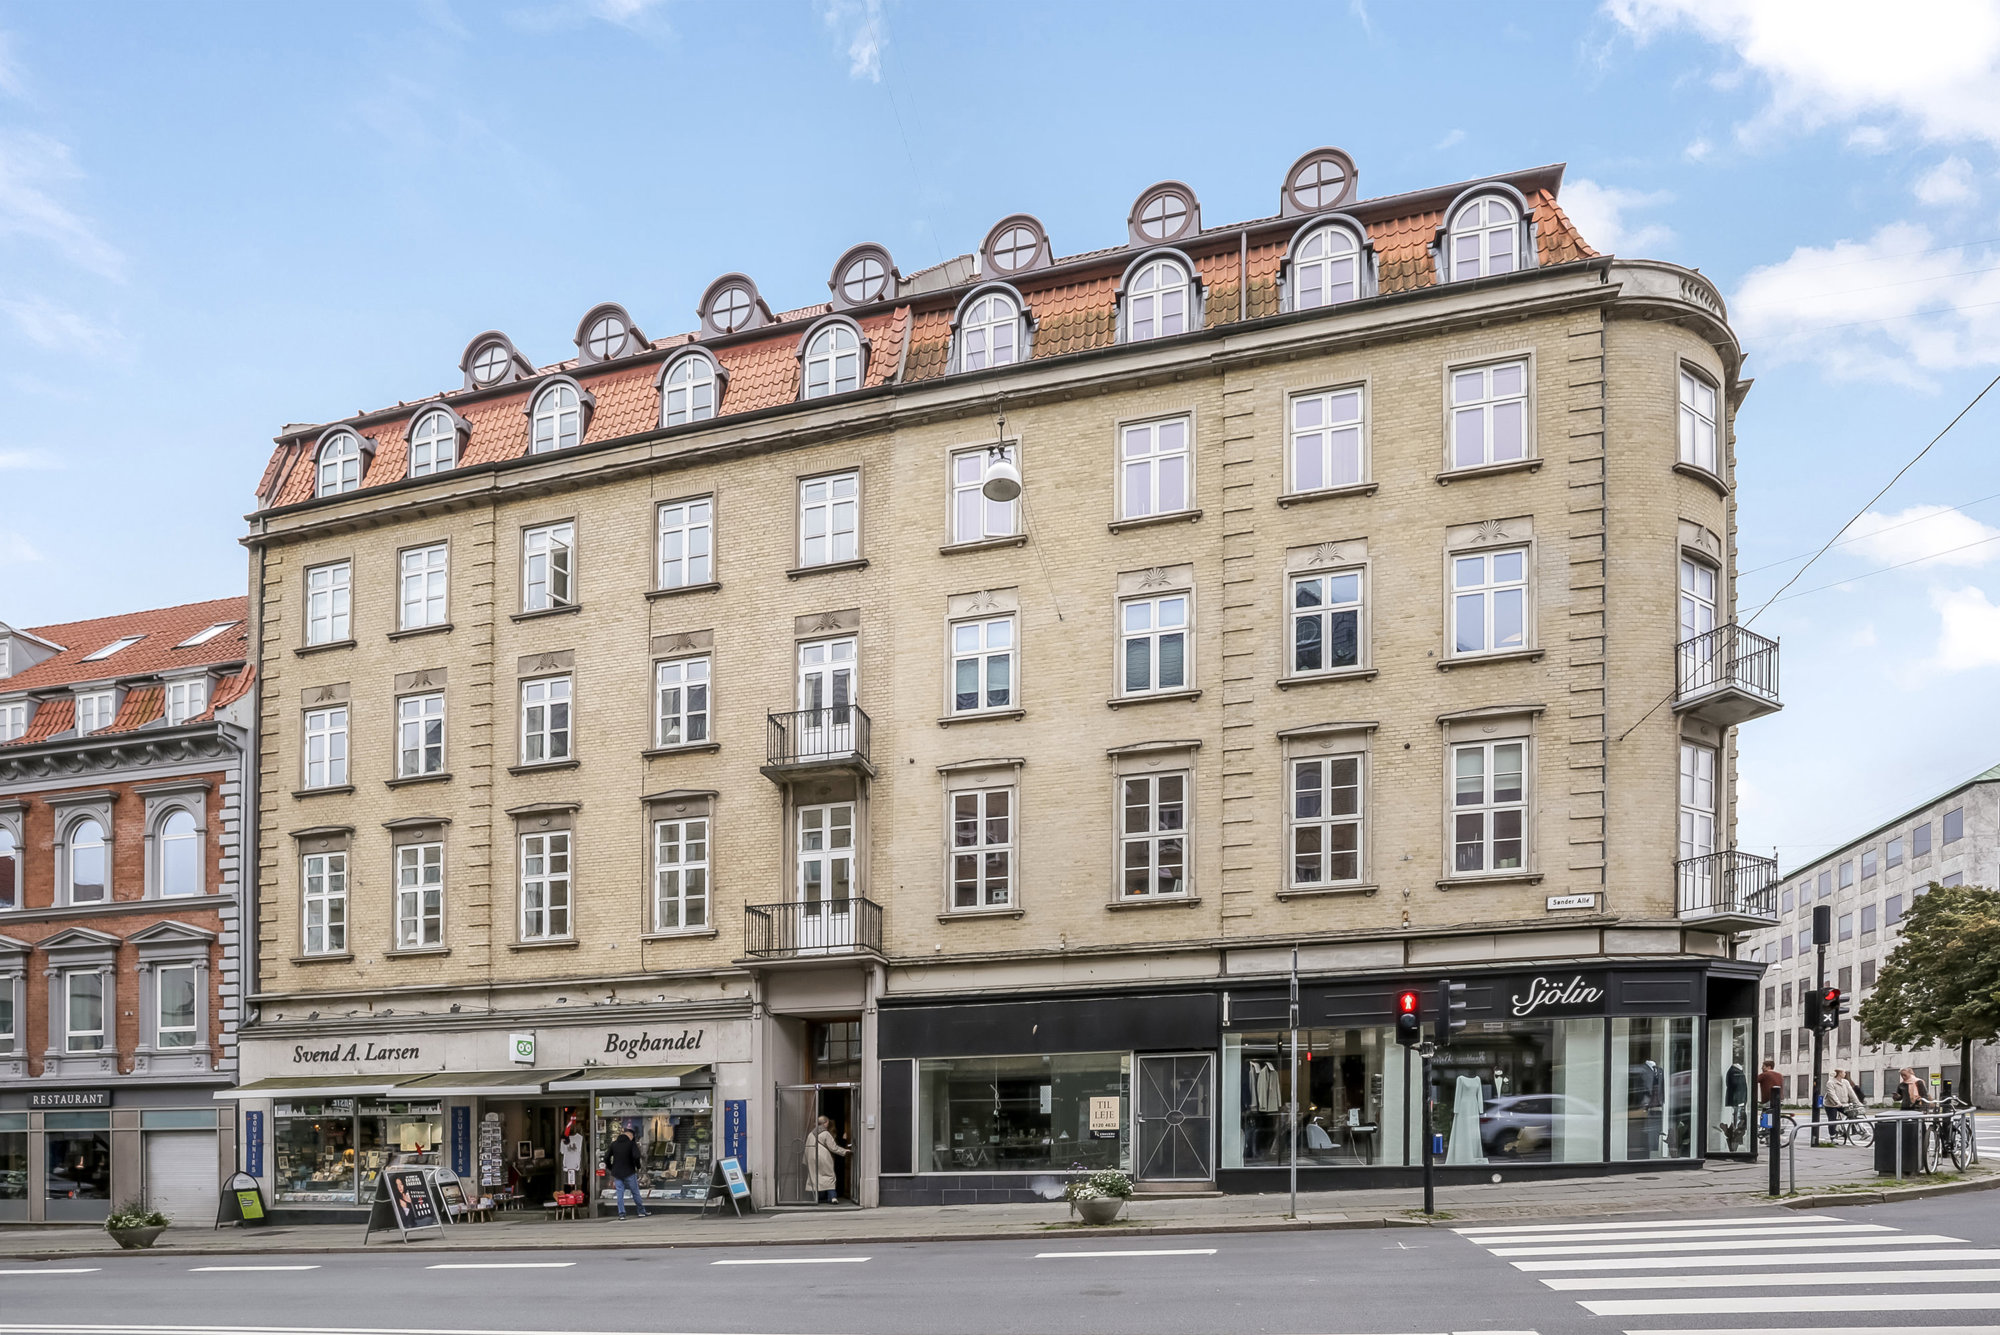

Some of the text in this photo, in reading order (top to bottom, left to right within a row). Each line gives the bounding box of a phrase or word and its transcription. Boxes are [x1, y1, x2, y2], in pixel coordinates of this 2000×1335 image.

[1512, 975, 1604, 1016] Sjölin
[604, 1029, 704, 1059] Boghandel
[293, 1042, 420, 1063] Svend A. Larsen
[33, 1094, 103, 1104] RESTAURANT
[1097, 1101, 1112, 1109] TIL
[1095, 1111, 1114, 1119] LEJE
